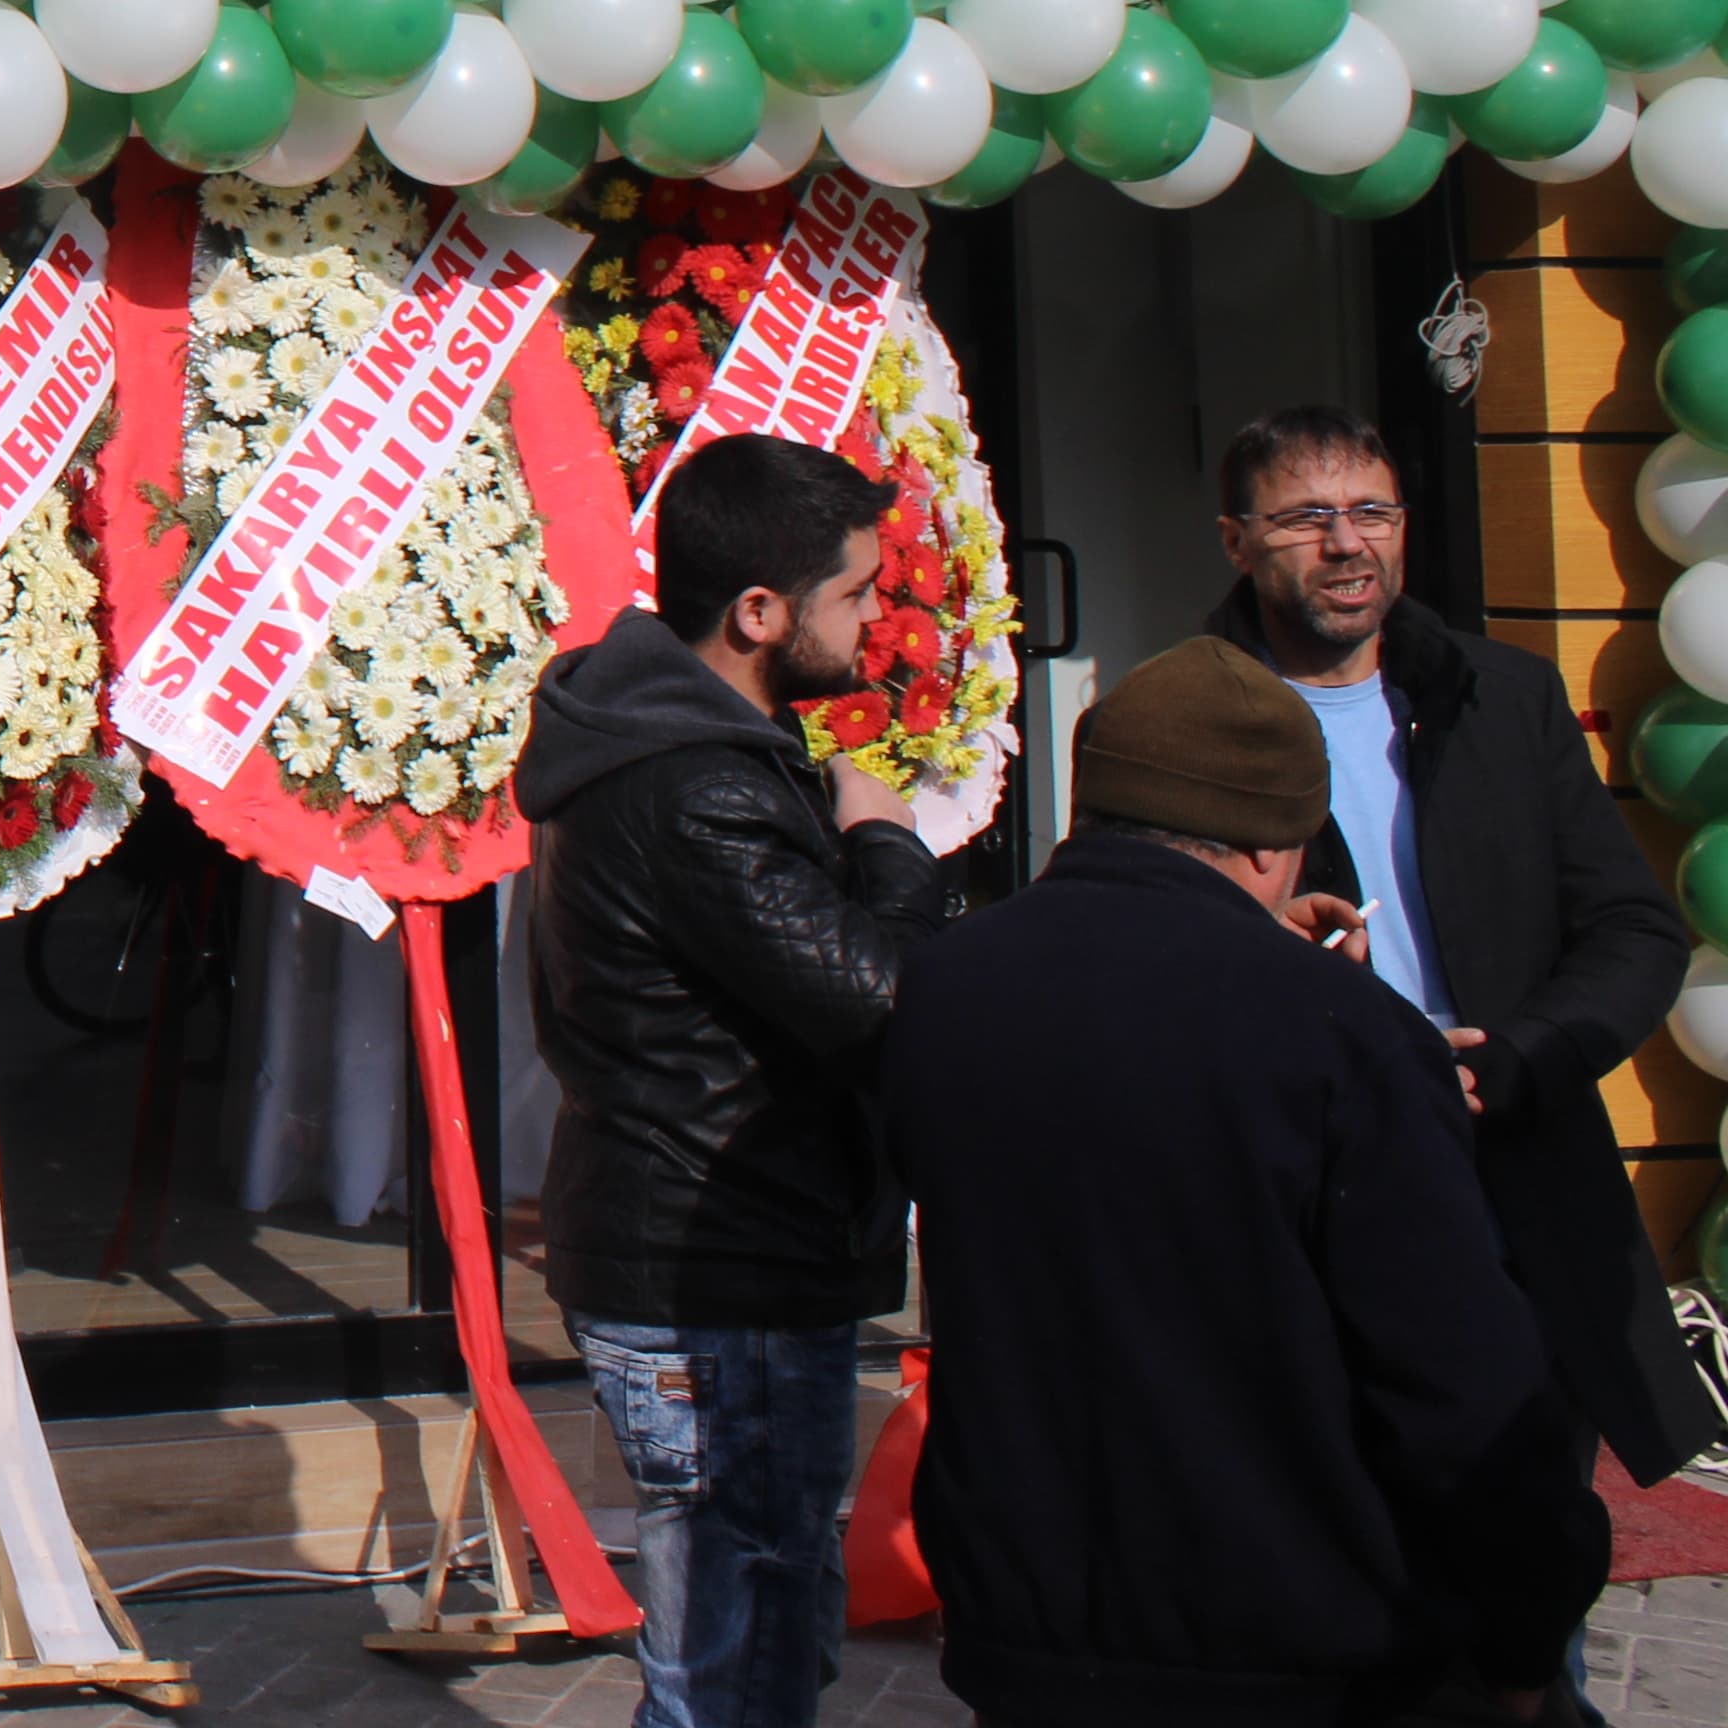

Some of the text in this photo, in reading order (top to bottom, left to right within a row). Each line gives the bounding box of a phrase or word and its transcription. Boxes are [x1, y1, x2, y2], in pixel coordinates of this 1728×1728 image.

[138, 397, 378, 700] SAKARYA
[202, 437, 426, 737] HAYIRLI
[407, 250, 545, 445] OLSUN
